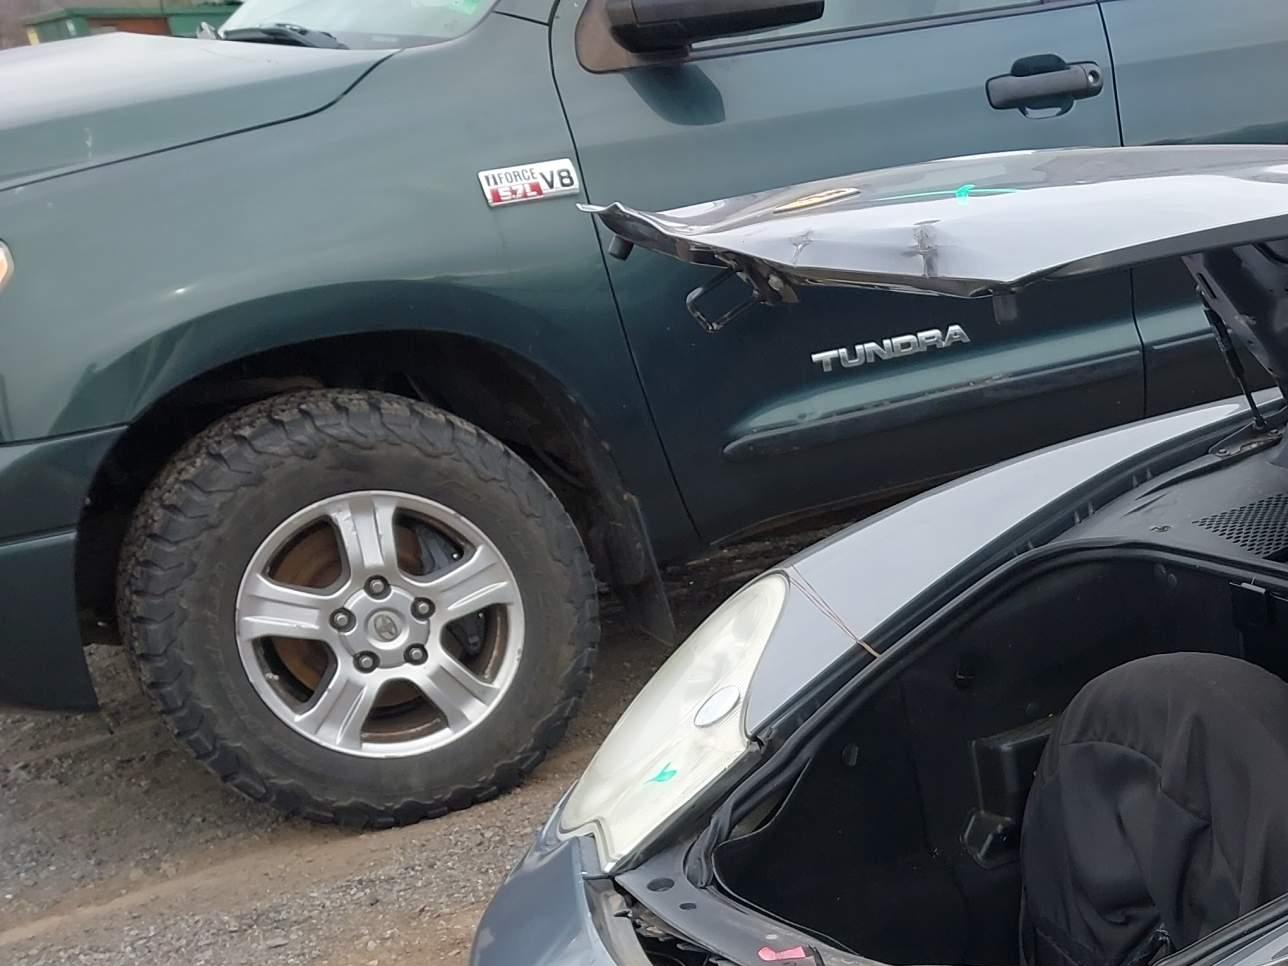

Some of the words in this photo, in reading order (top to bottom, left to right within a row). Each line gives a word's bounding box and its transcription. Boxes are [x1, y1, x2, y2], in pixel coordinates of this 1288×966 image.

[540, 168, 575, 190] V8
[497, 183, 538, 201] 5.7L
[811, 324, 971, 372] TUNDRA
